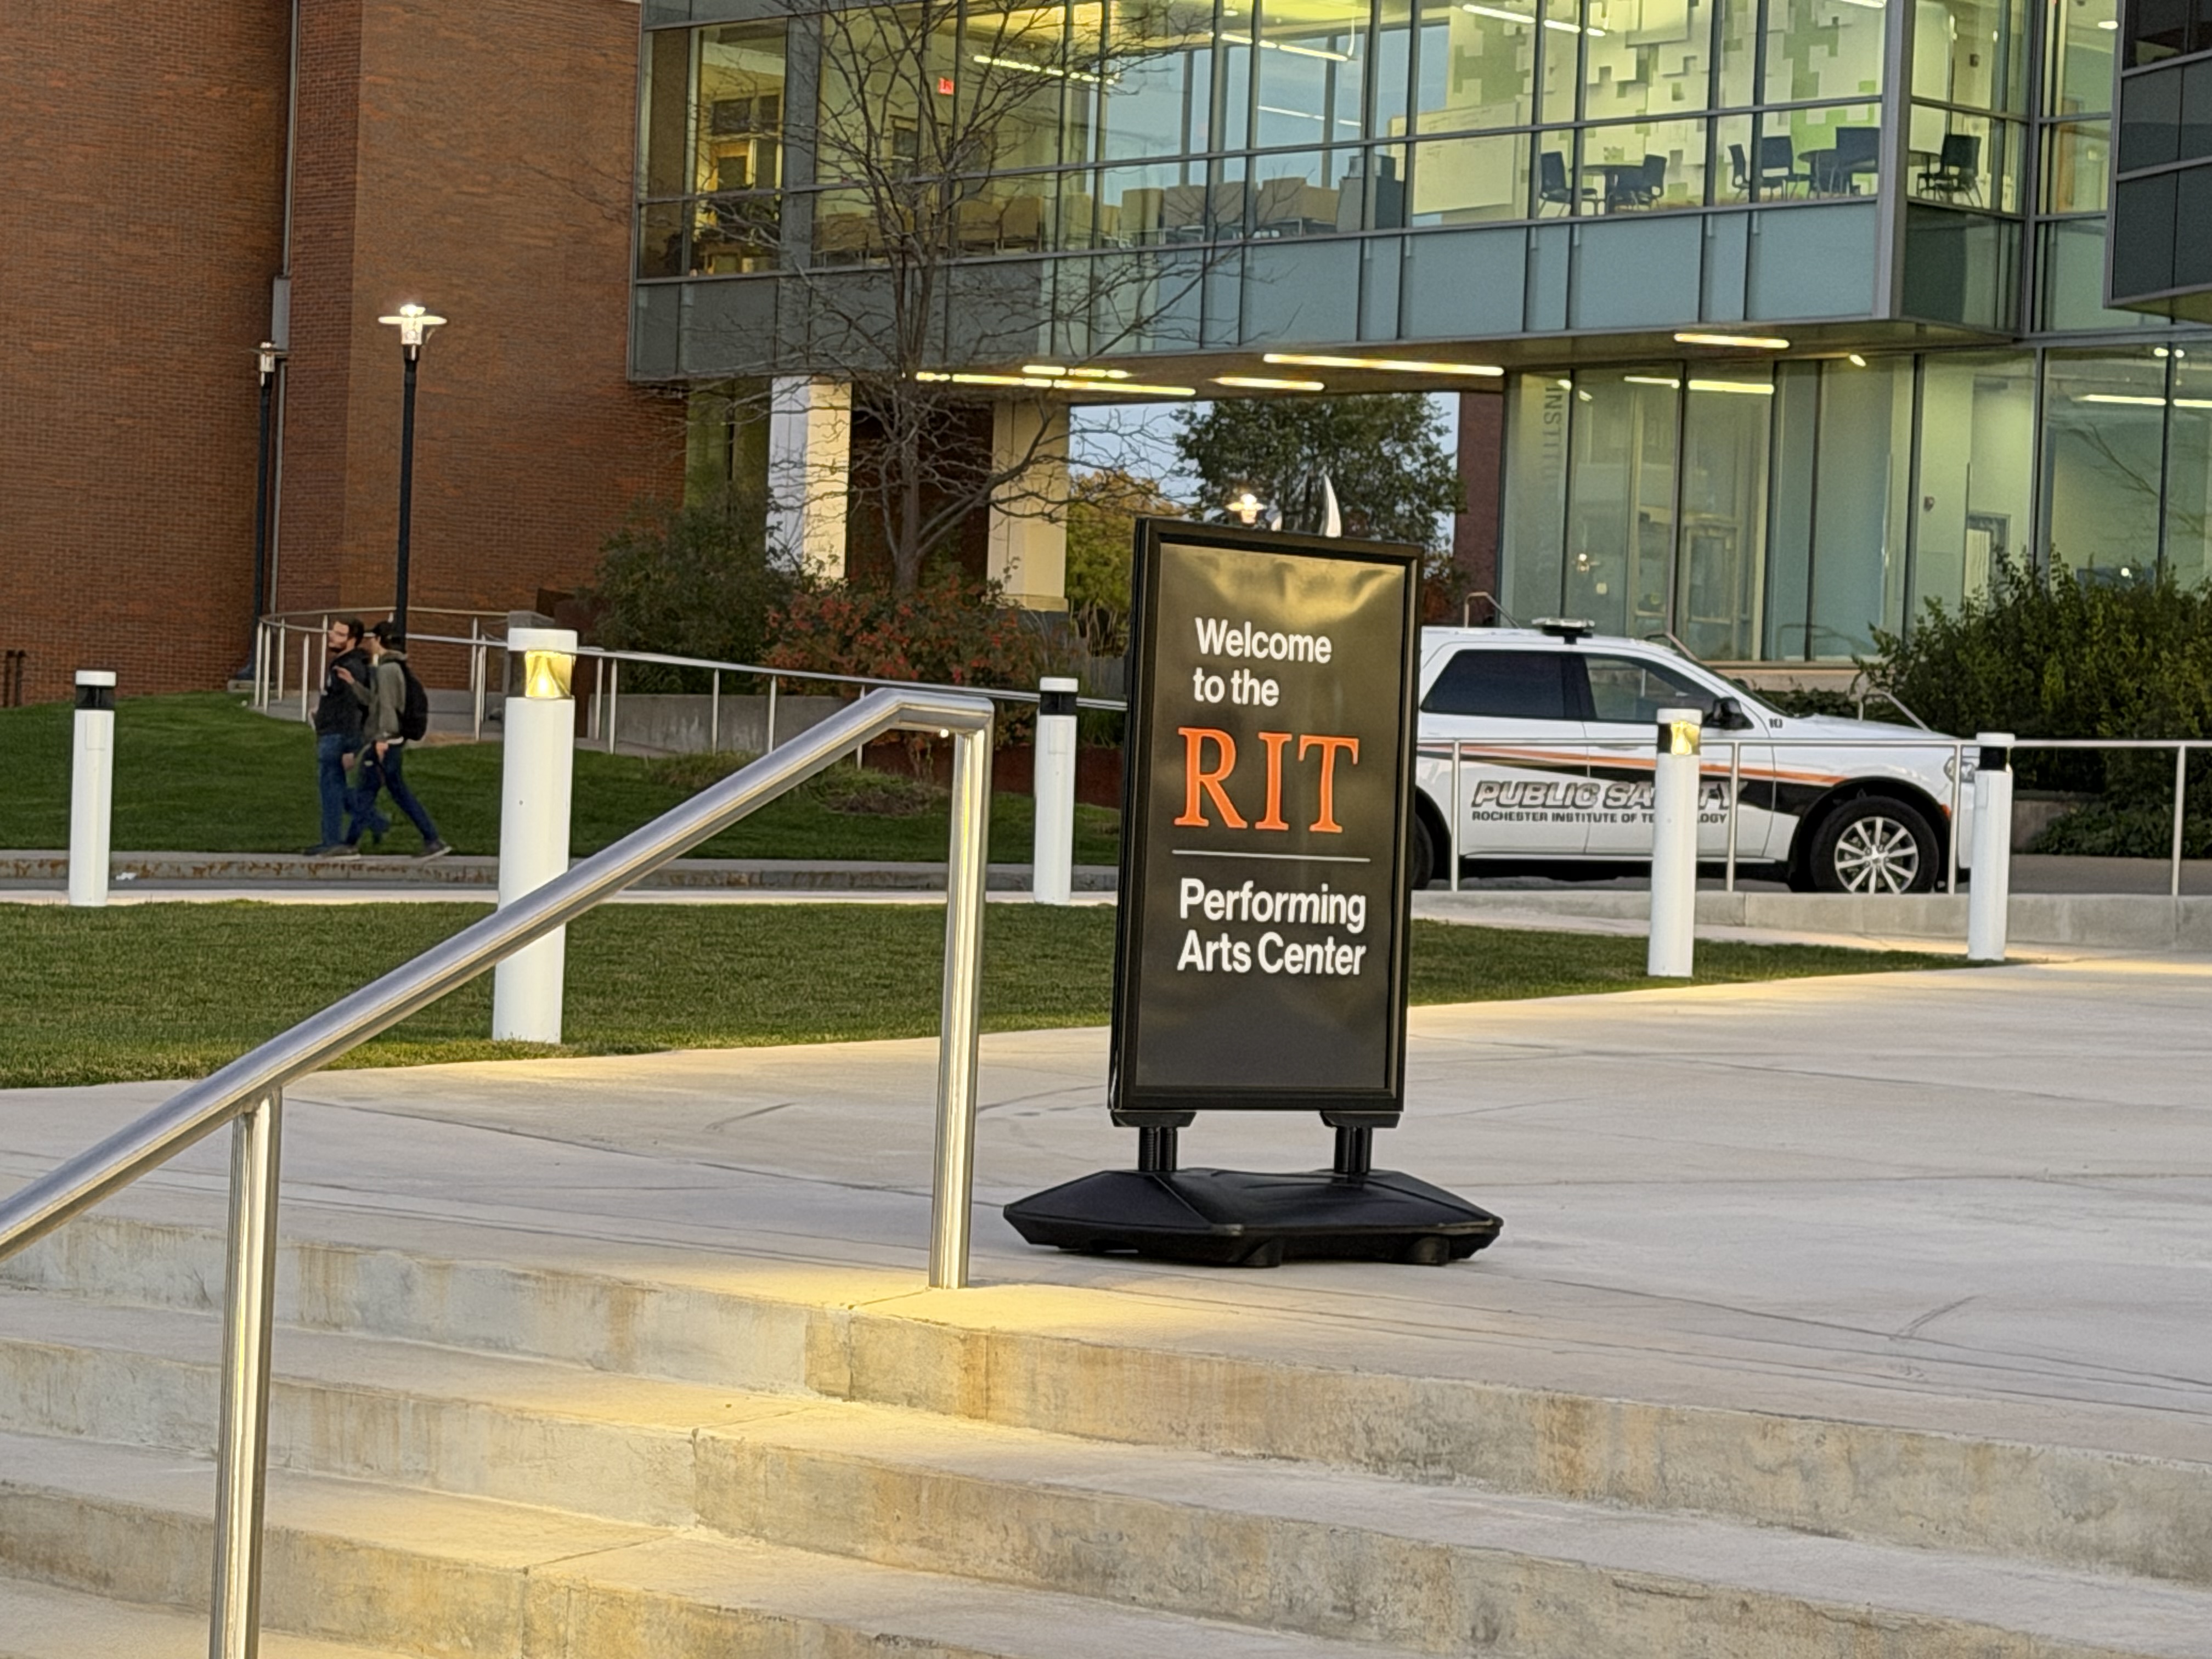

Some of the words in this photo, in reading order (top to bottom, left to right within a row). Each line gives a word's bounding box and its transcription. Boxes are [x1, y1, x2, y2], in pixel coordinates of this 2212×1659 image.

[1195, 617, 1333, 664] Welcome
[1193, 667, 1225, 704] to
[1230, 668, 1280, 707] the
[1175, 726, 1360, 834] RIT
[1471, 780, 1600, 809] PUBLIC
[1602, 781, 1748, 810] SATY
[1471, 810, 1548, 822] ROCHESTER
[1551, 812, 1617, 823] INSTITUTE
[1621, 812, 1637, 823] OF
[1641, 812, 1728, 824] TEOGY
[1180, 877, 1367, 934] Performing
[1177, 929, 1251, 973] Arts
[1258, 931, 1367, 975] Center
